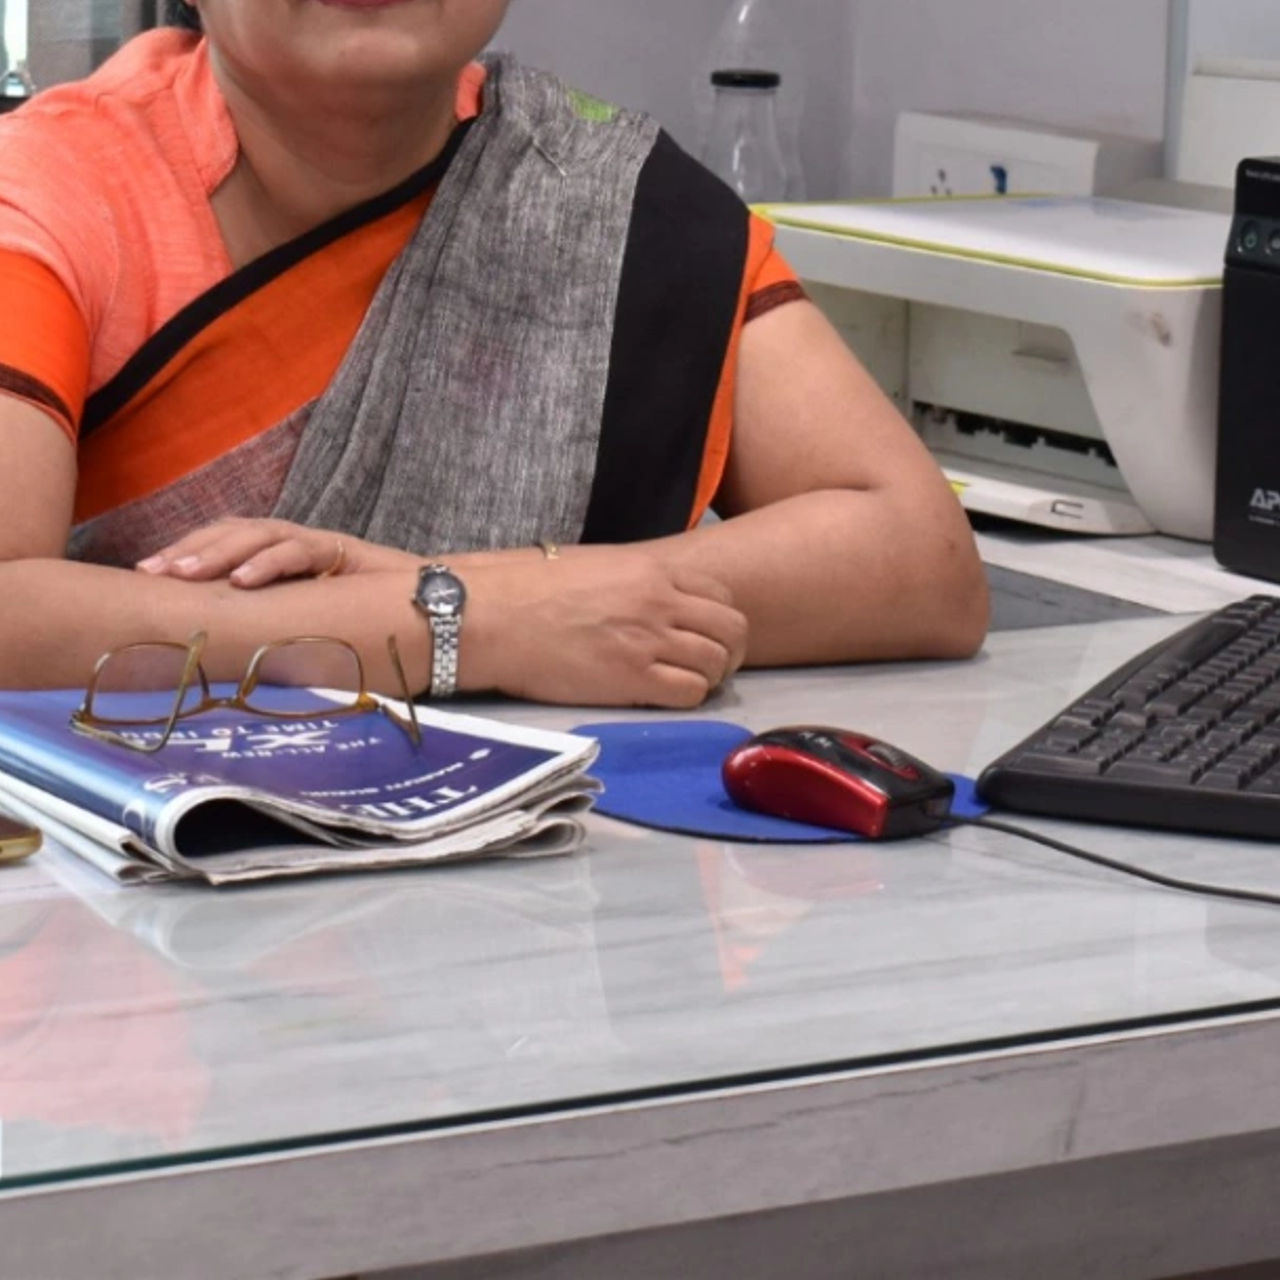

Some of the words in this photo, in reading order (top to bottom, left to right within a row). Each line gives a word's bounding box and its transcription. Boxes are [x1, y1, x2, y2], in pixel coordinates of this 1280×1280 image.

[211, 724, 255, 737] TO
[262, 719, 340, 734] TIME
[332, 735, 383, 750] THE
